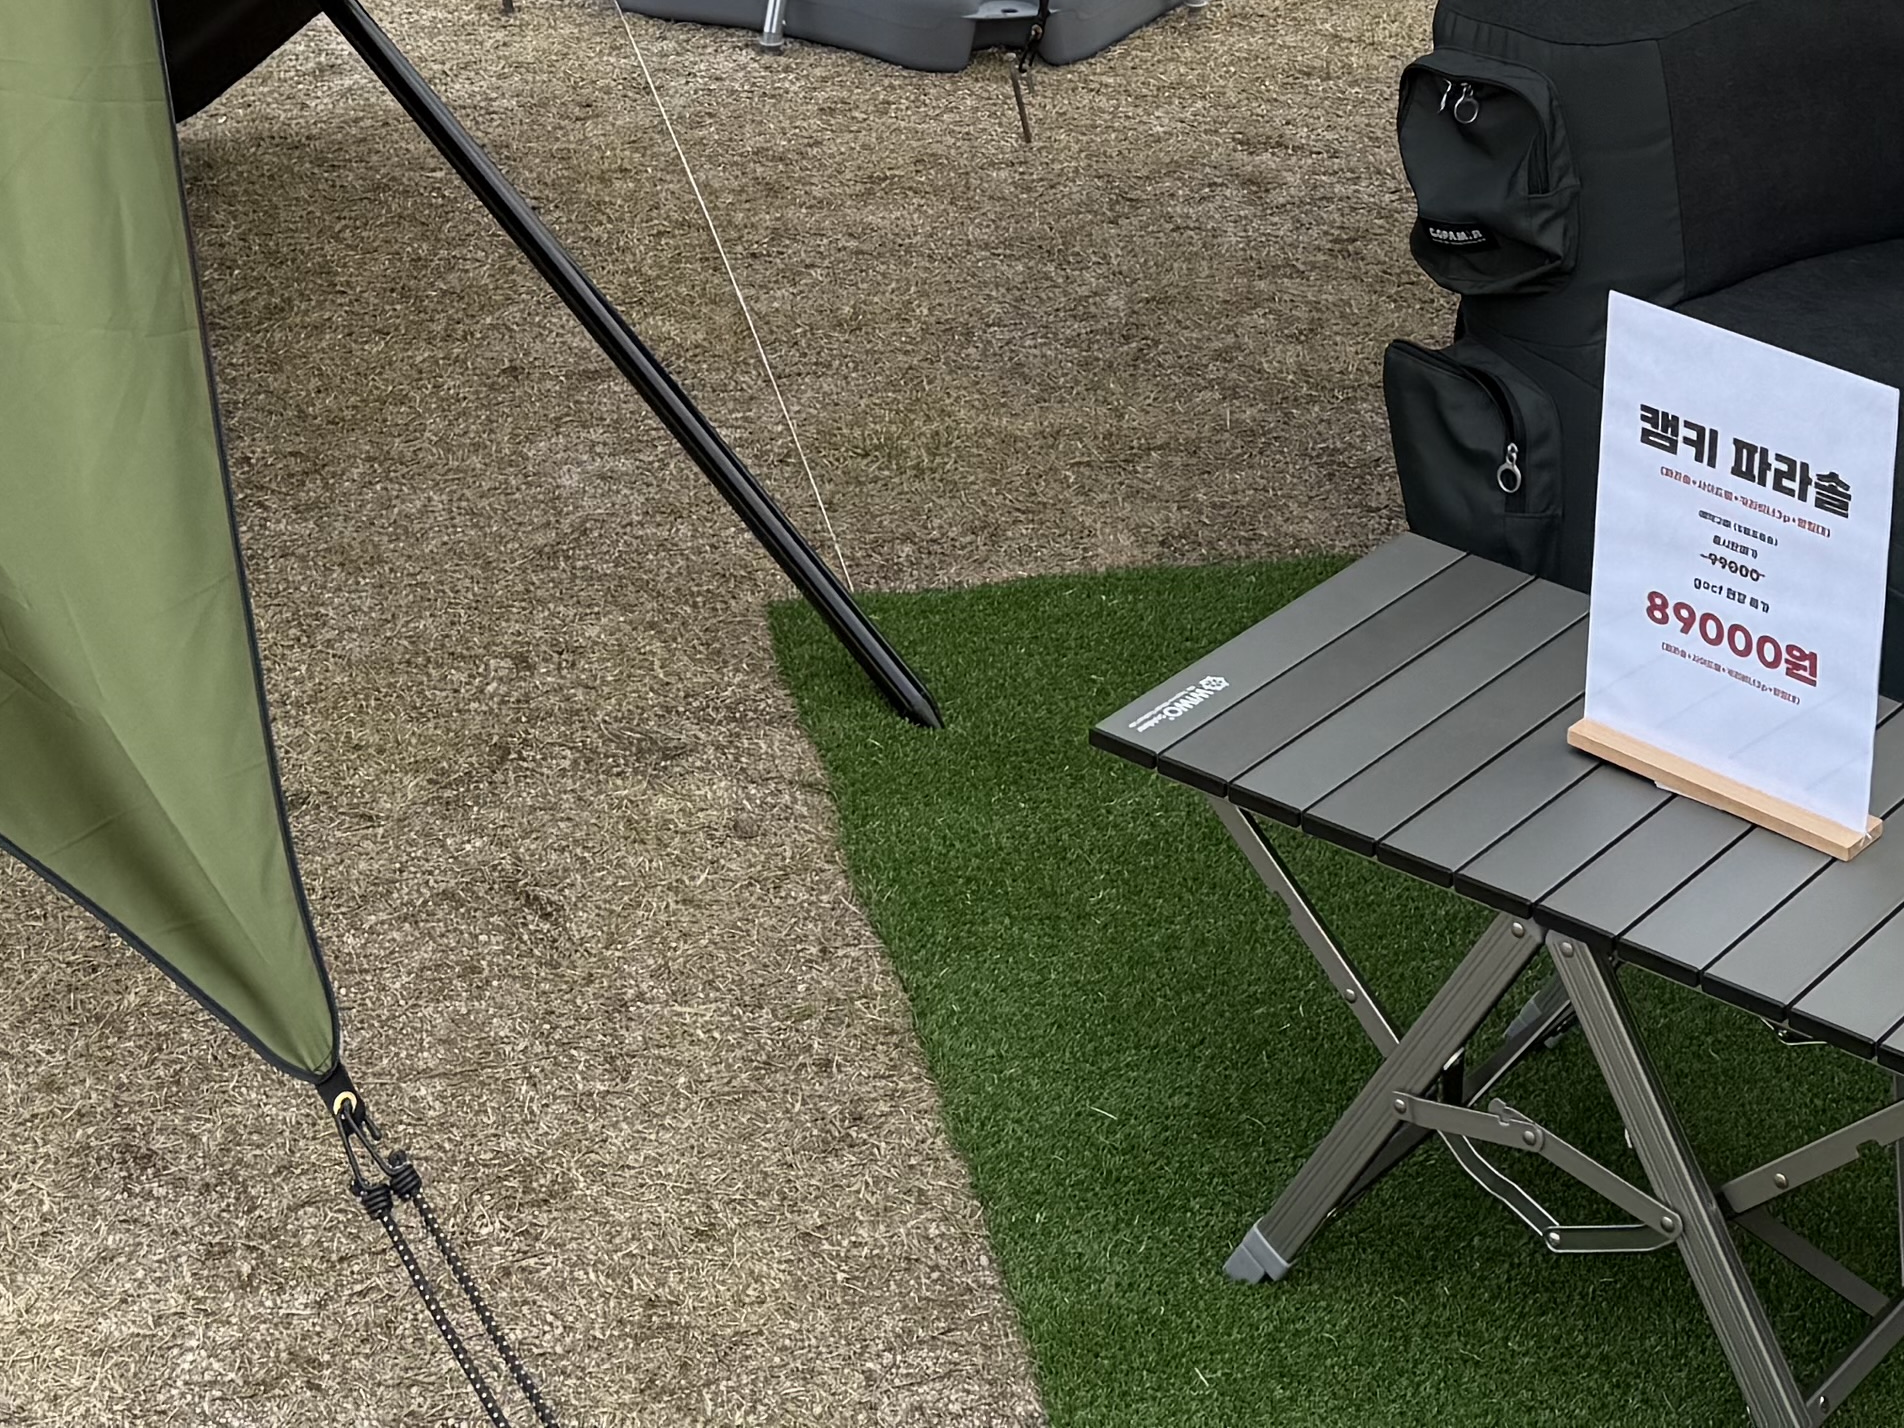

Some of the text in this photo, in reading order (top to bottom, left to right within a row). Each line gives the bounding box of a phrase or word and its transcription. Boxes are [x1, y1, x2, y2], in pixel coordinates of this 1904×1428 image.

[1640, 403, 1718, 469] 캠키
[1730, 437, 1852, 519] 파라솔
[1646, 590, 1818, 687] 89000원
